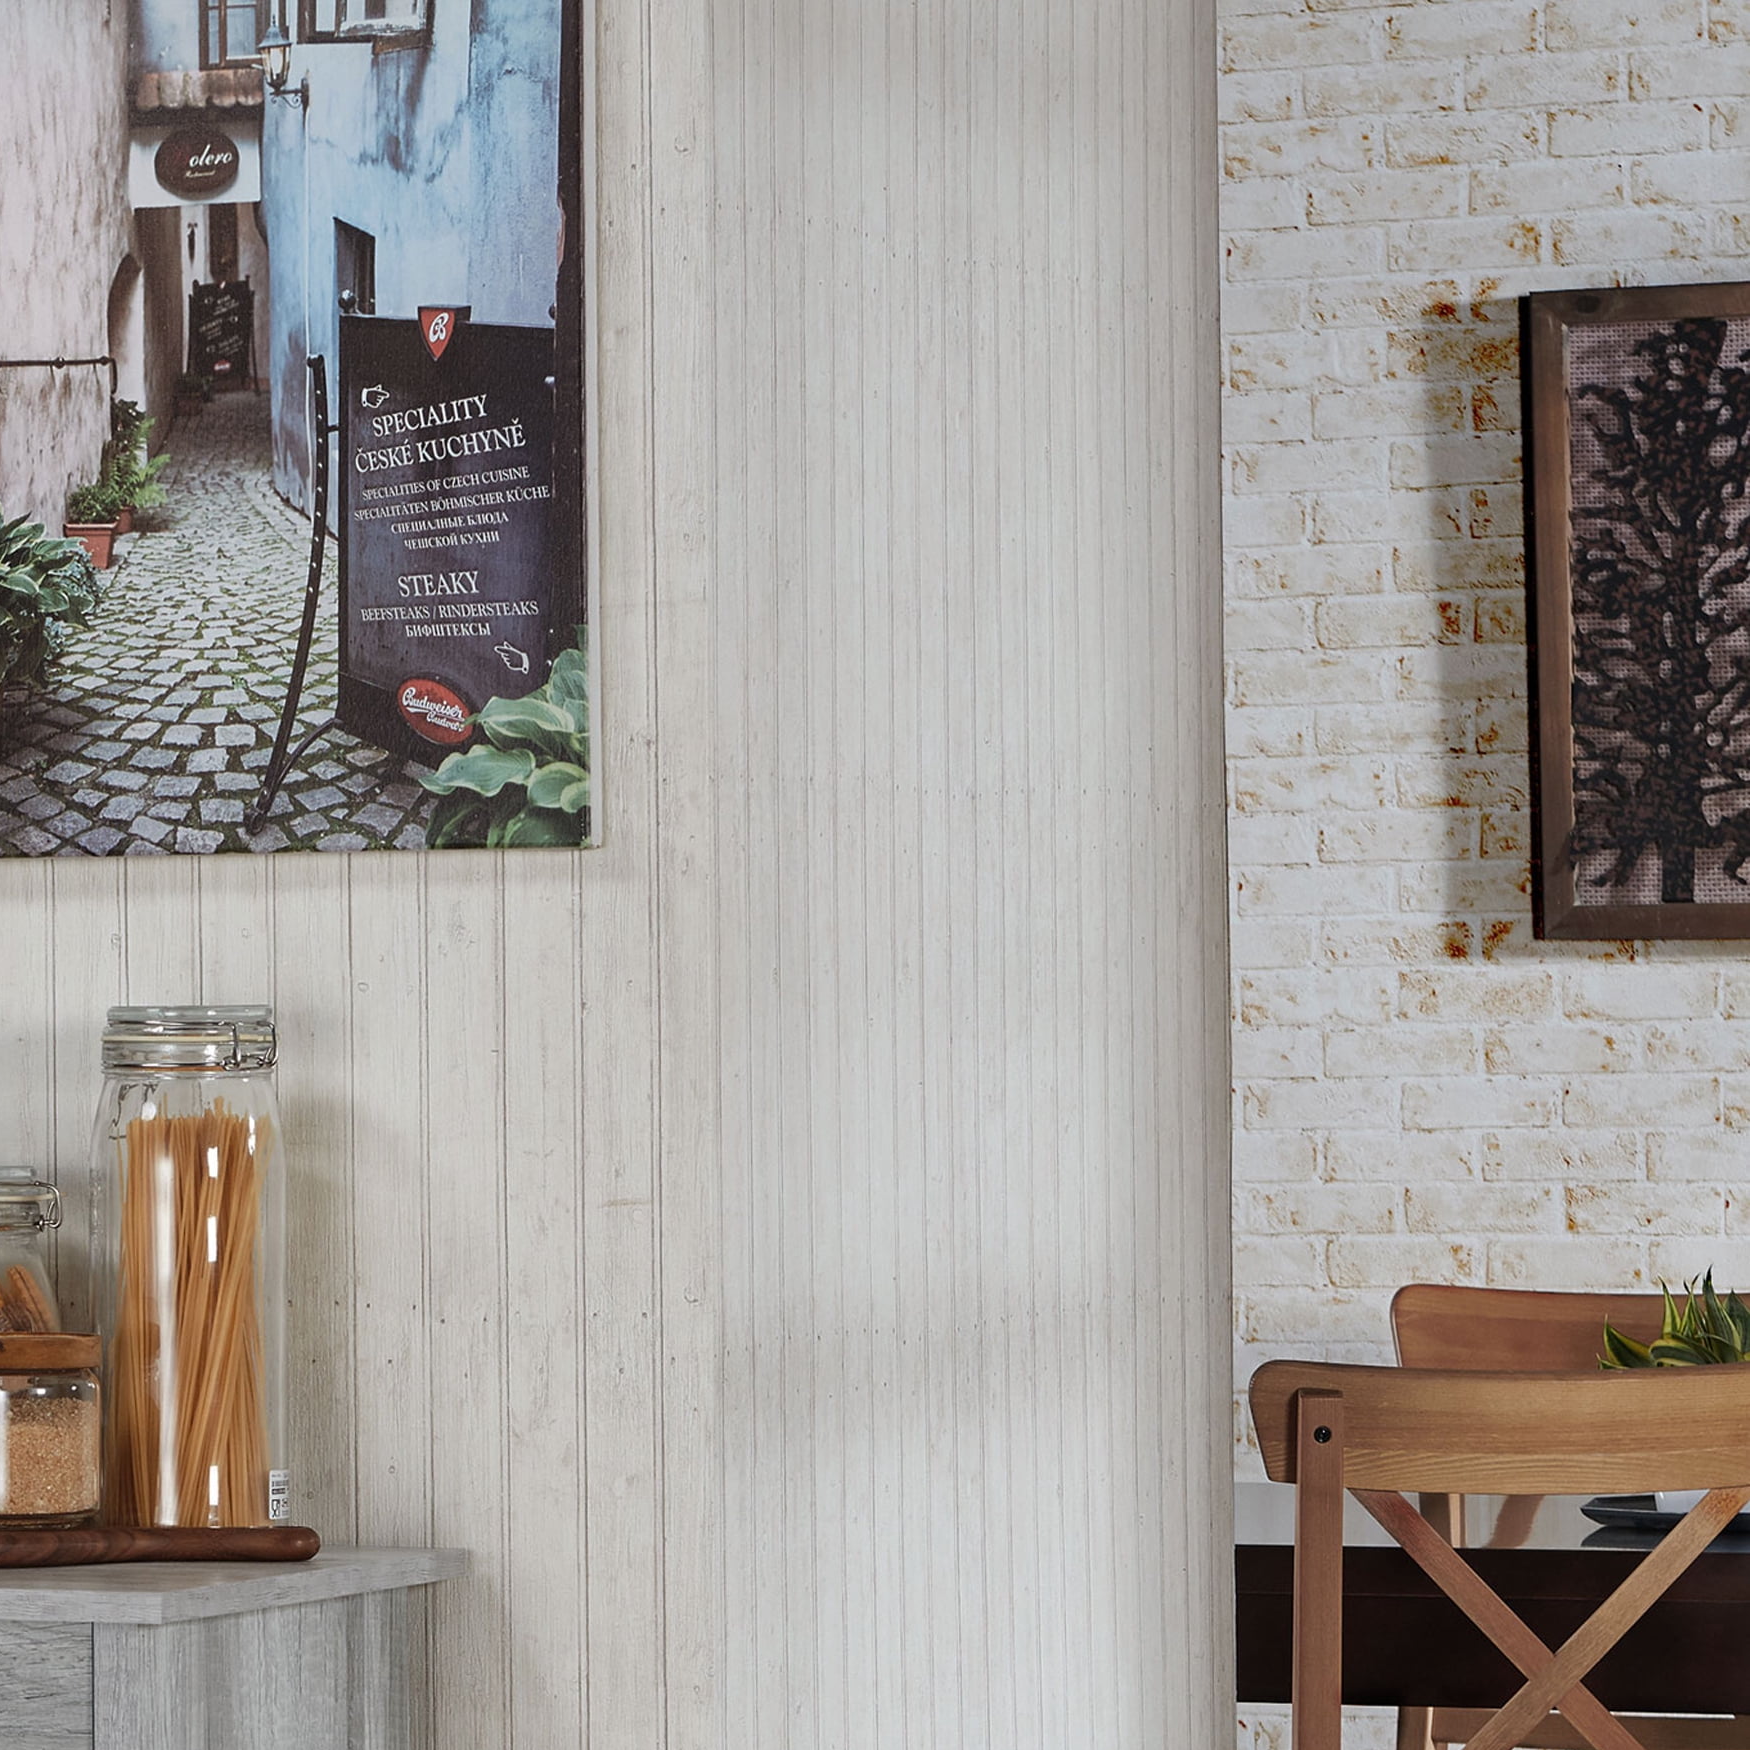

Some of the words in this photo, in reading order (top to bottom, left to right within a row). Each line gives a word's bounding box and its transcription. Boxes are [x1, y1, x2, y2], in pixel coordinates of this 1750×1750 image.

[372, 394, 489, 438] SPECIALITY
[355, 439, 414, 473] ČESKÉ
[416, 417, 526, 463] KUCHYNĚ
[362, 481, 426, 501] SPECIALITIES
[426, 479, 441, 492] OF
[442, 473, 480, 490] CZECH
[481, 465, 530, 485] CUISINE
[506, 485, 550, 502] KÜCHE
[459, 530, 500, 546] КУХНИ
[398, 571, 480, 598] STEAKY
[360, 605, 430, 622] BEEFSTEAKS
[438, 600, 539, 619] RINDERSTEAKS
[405, 622, 492, 638] БИФШТЕКСЫ
